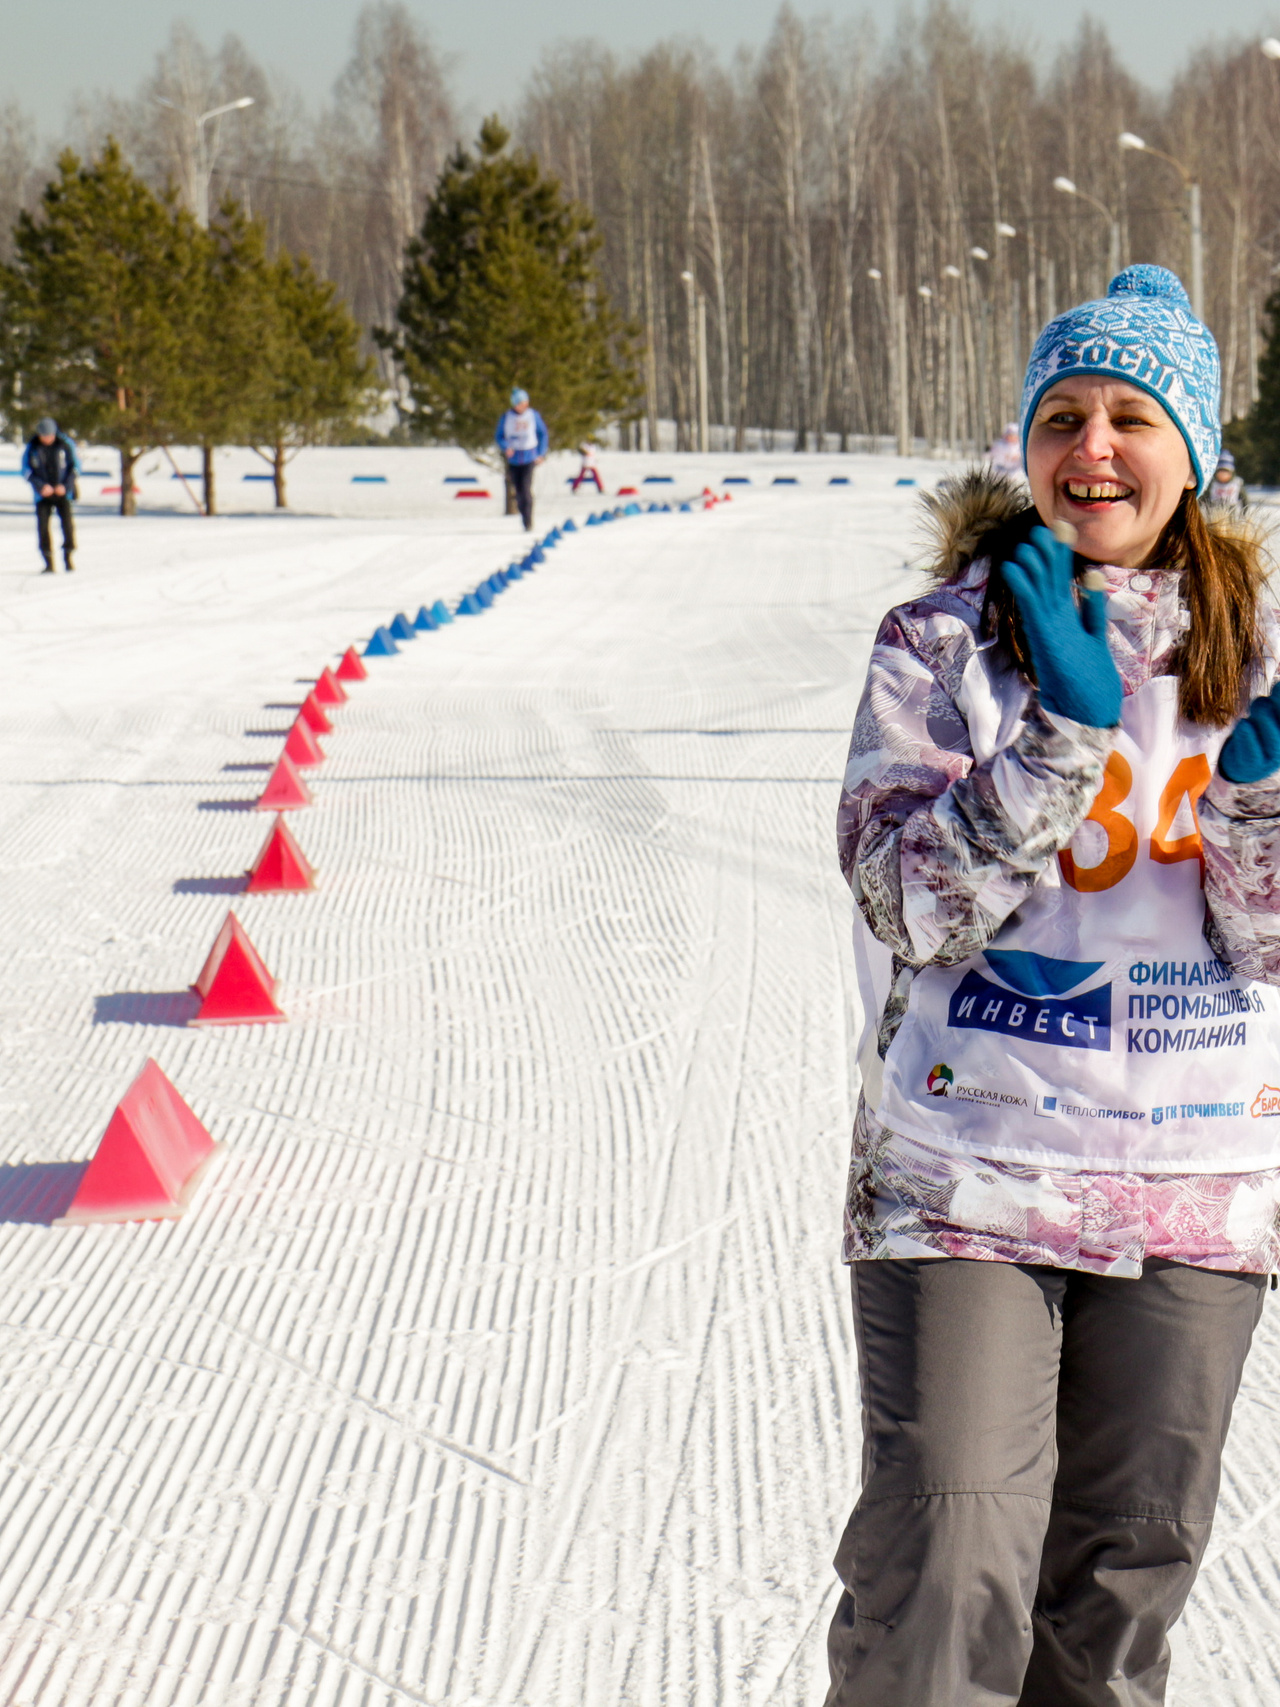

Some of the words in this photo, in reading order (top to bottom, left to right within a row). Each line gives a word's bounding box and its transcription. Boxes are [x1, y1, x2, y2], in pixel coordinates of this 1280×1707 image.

[1056, 343, 1175, 394] SOCHI
[1057, 749, 1212, 893] 34
[956, 995, 1099, 1040] ИНВЕСТ
[1127, 1021, 1247, 1054] КОМПАНИЯ
[956, 1085, 999, 1102] РУССКАЯ
[999, 1093, 1029, 1108] КОЖА
[1060, 1103, 1146, 1121] ТЕПЛОПРИБОР
[1165, 1105, 1178, 1120] ГК
[1180, 1101, 1246, 1119] ТОЧИНВЕСТ
